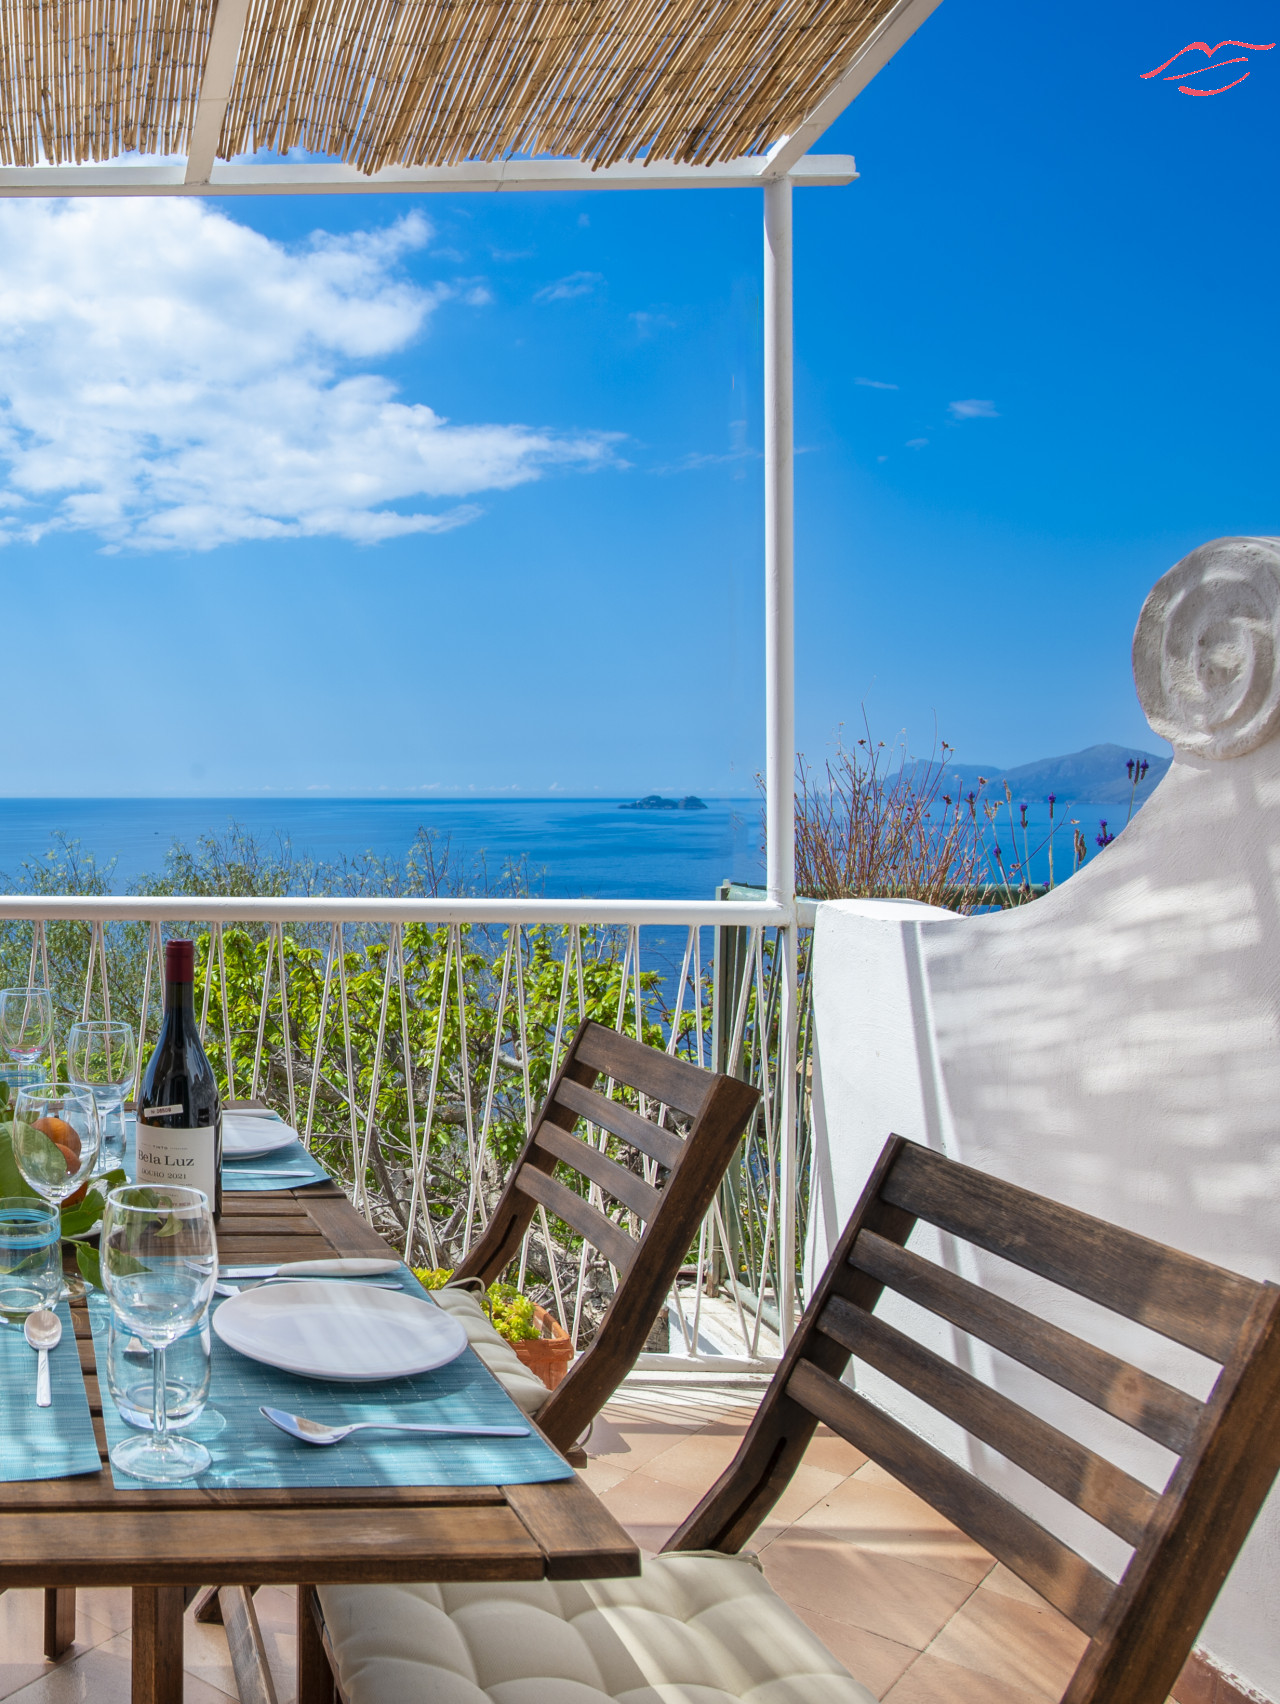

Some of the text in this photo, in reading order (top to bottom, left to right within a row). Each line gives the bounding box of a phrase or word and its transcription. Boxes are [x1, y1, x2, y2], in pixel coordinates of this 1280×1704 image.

[138, 1149, 195, 1167] Bela Luz
[141, 1168, 165, 1178] DOURO
